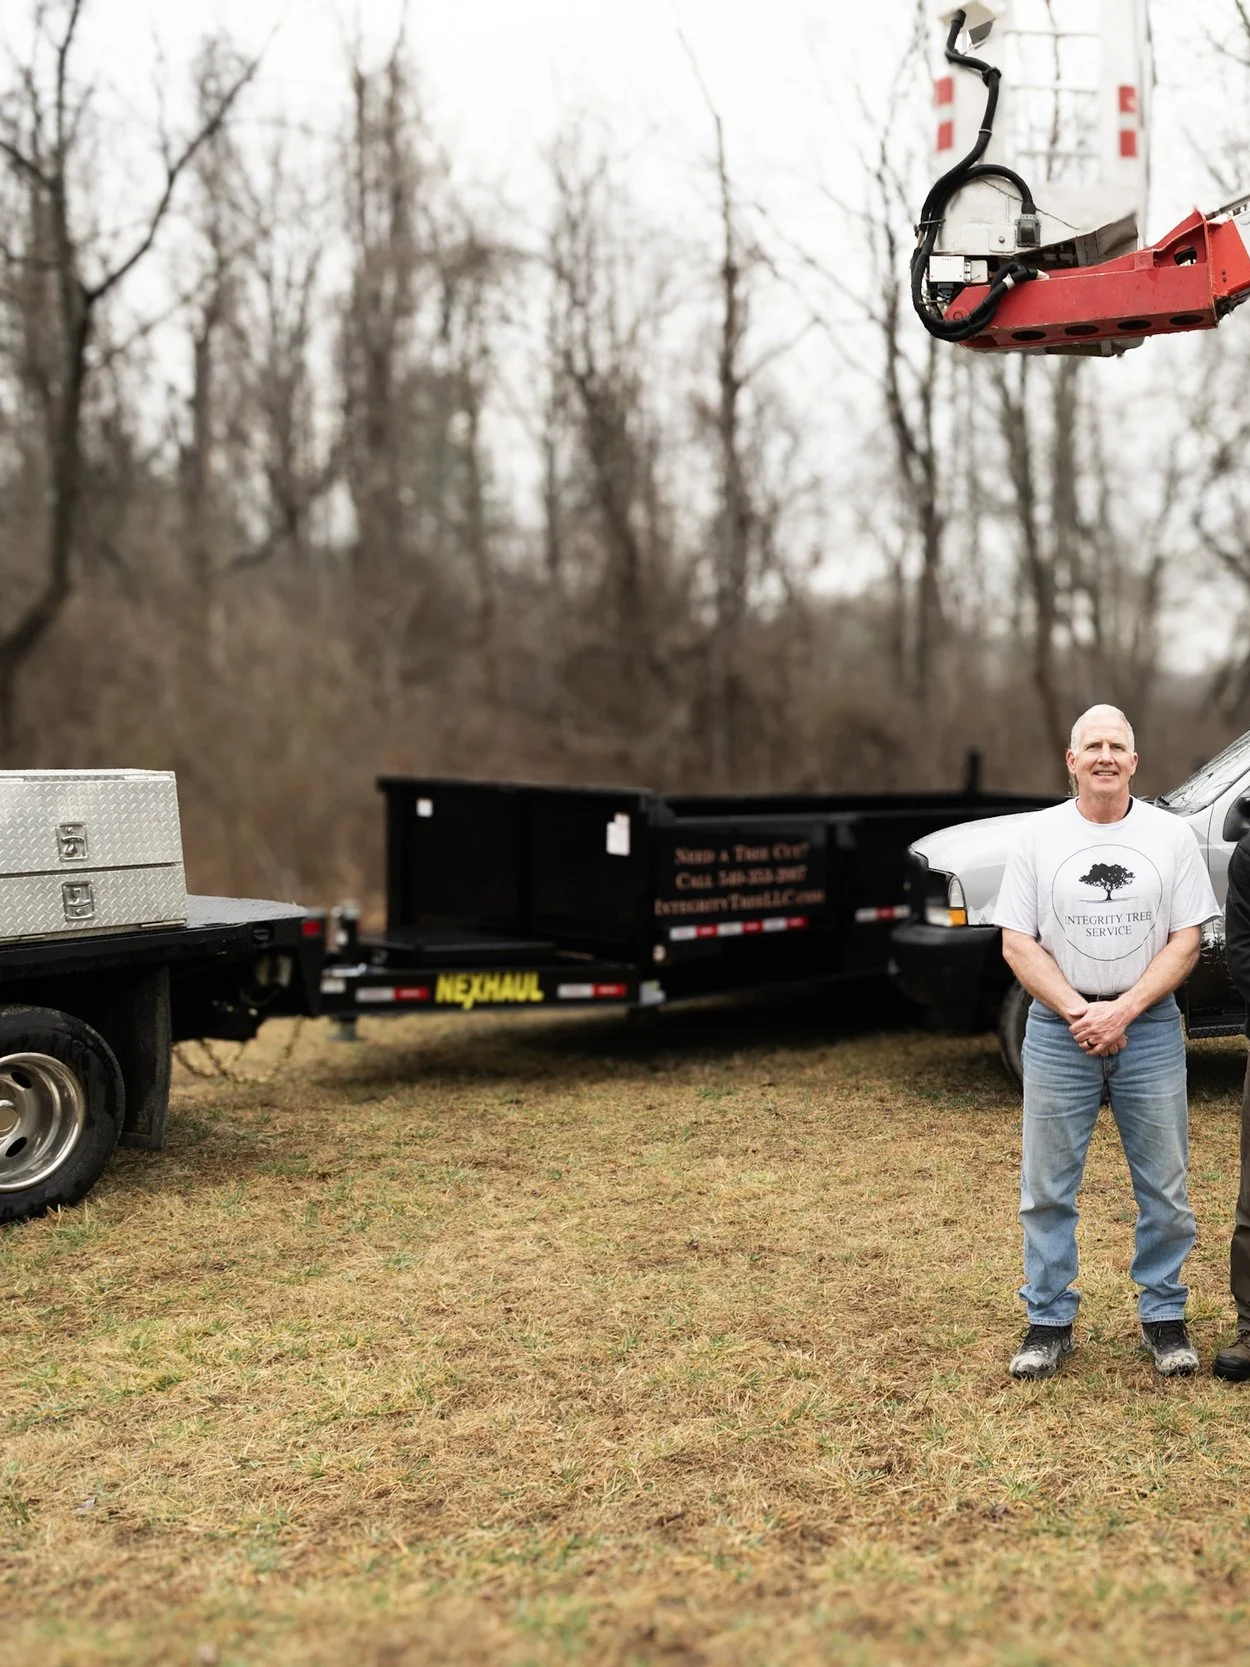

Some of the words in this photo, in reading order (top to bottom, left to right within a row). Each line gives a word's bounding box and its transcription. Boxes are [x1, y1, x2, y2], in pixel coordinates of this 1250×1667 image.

[1064, 913, 1123, 925] INTEGRITY
[1125, 911, 1152, 922] TREE
[1085, 925, 1132, 937] SERVICE
[435, 971, 545, 1011] NEXHAUL
